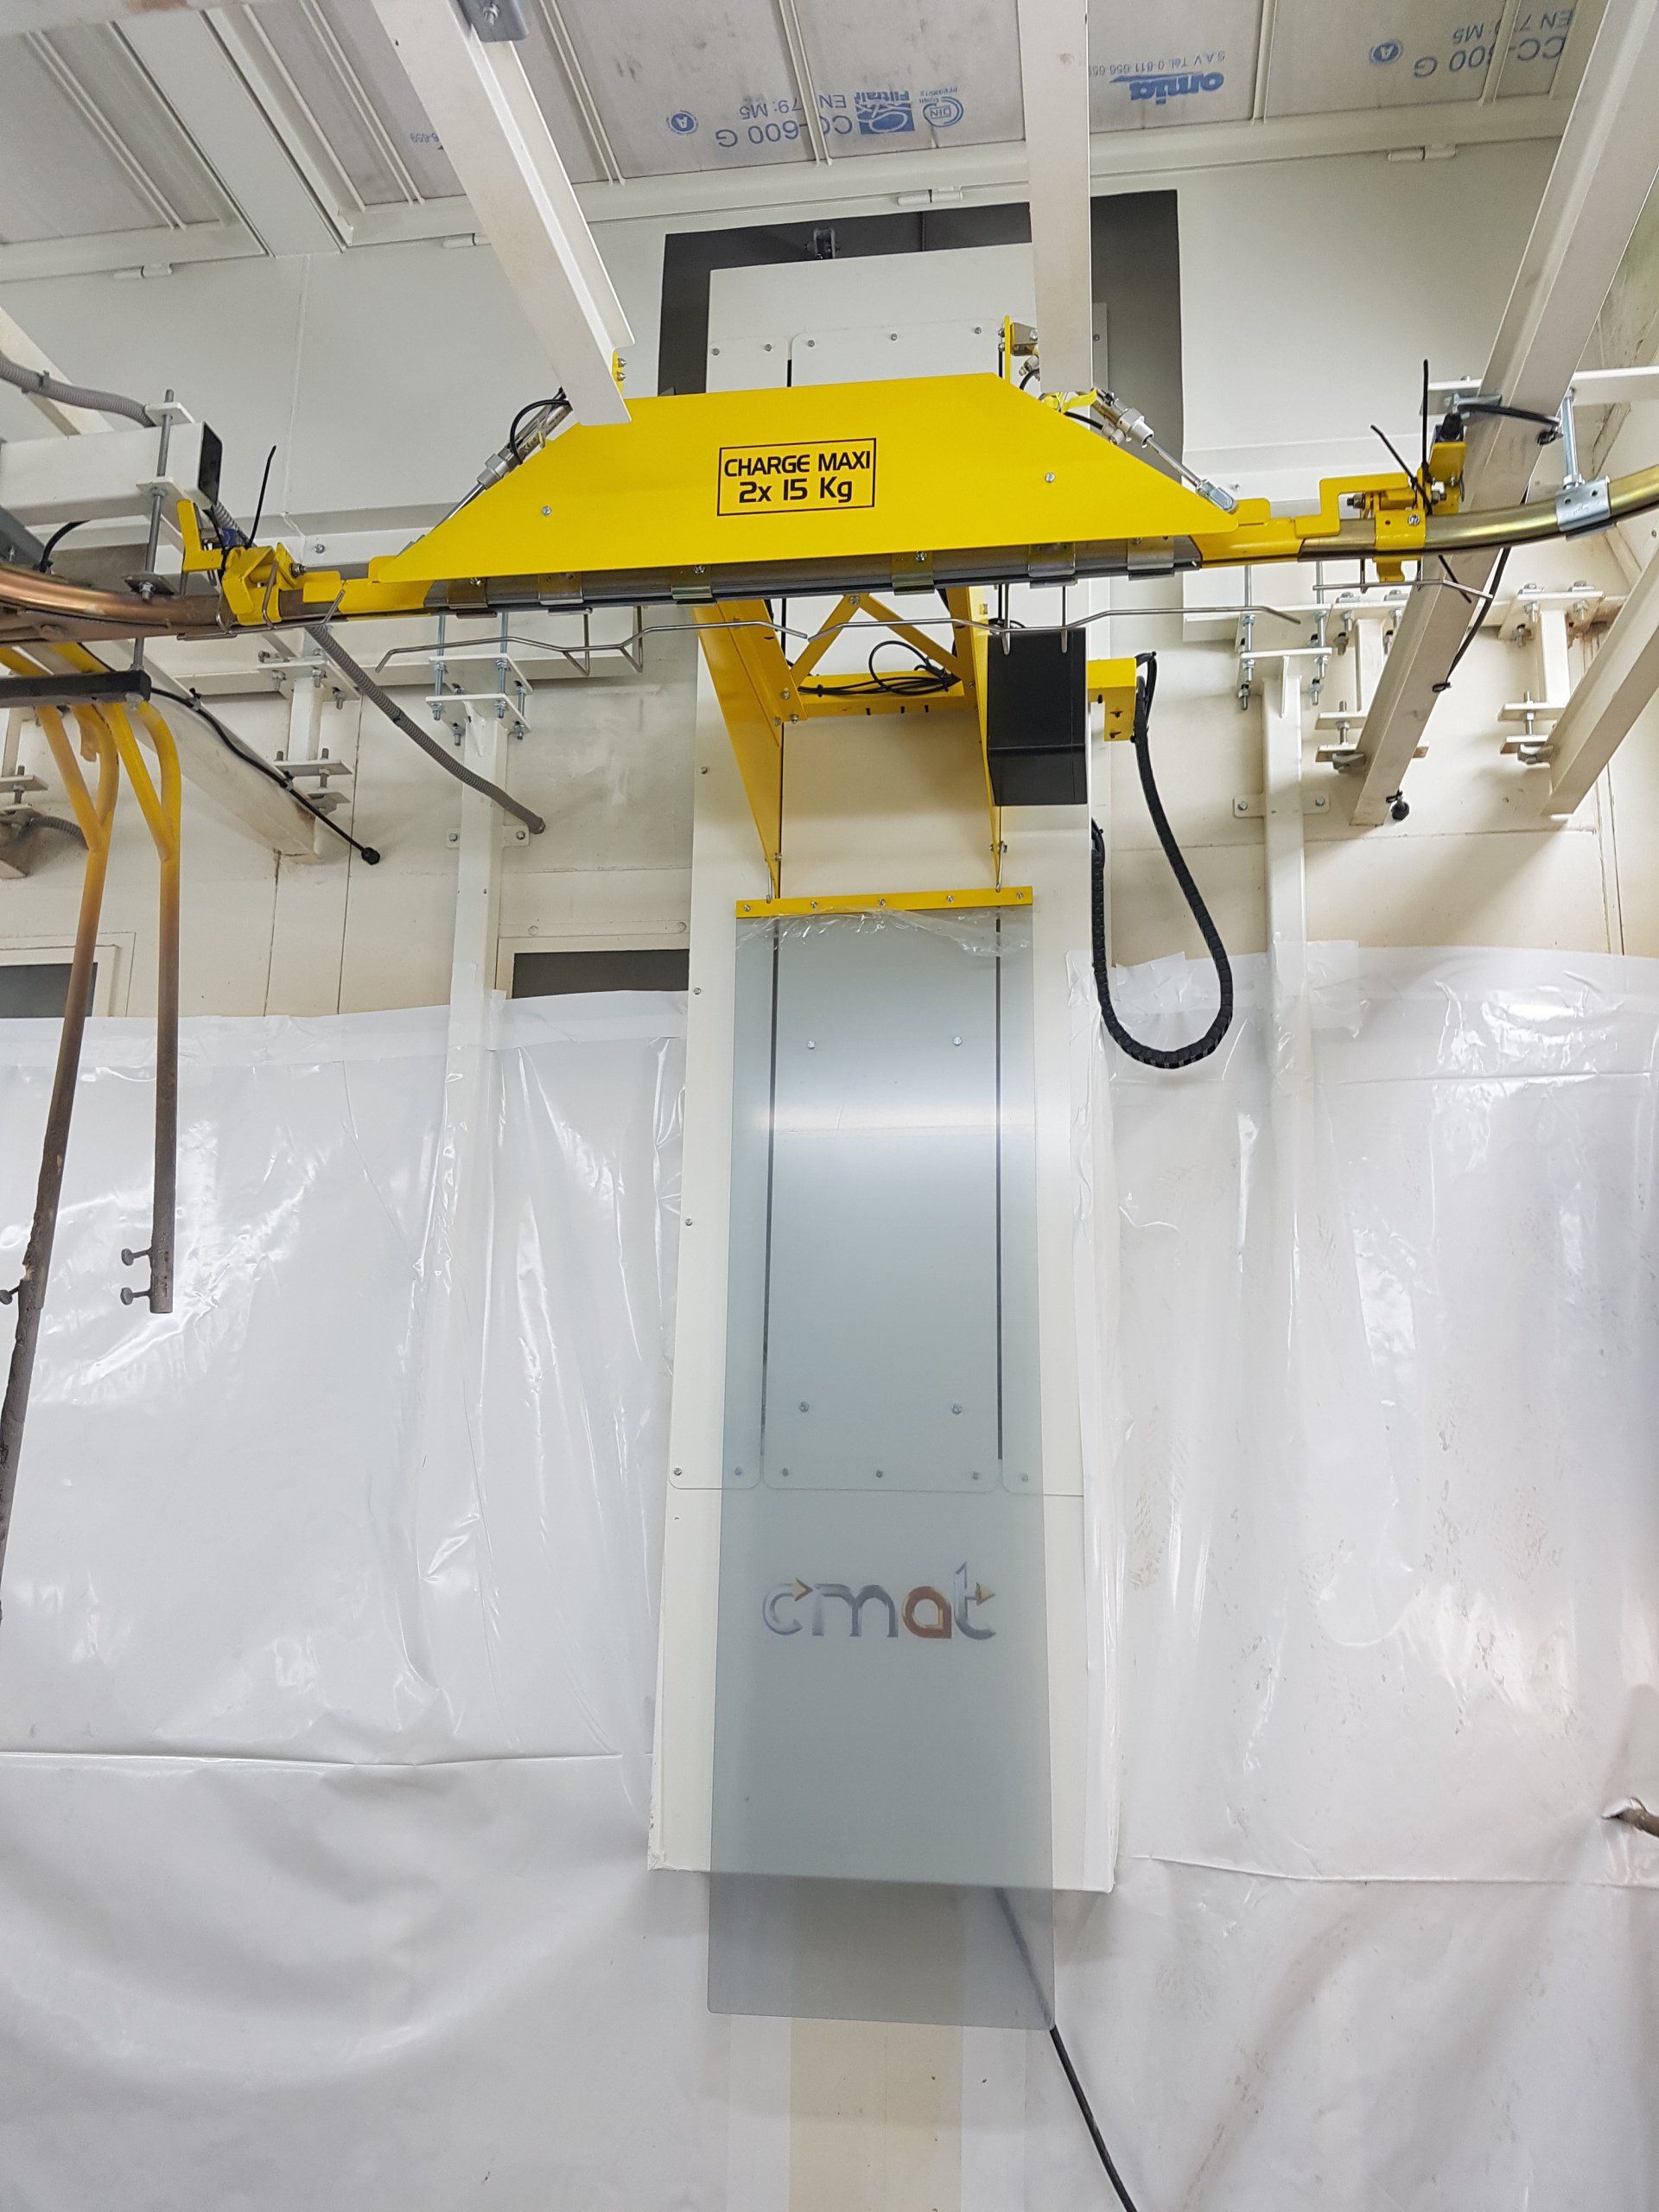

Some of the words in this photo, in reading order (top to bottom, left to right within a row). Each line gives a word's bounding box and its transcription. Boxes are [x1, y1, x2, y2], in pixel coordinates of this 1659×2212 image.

[1452, 23, 1484, 44] M5
[1413, 56, 1437, 78] G
[855, 90, 911, 105] Filtrair
[1129, 72, 1224, 106] omia
[739, 103, 768, 121] M5
[772, 96, 802, 114] 79:
[819, 94, 847, 110] EN
[715, 130, 739, 148] G
[724, 454, 810, 477] CHARGE
[817, 450, 871, 472] MAXI
[739, 481, 772, 503] 2x
[783, 478, 808, 500] 15
[820, 476, 852, 503] Kg
[762, 1560, 997, 1640] cmat
